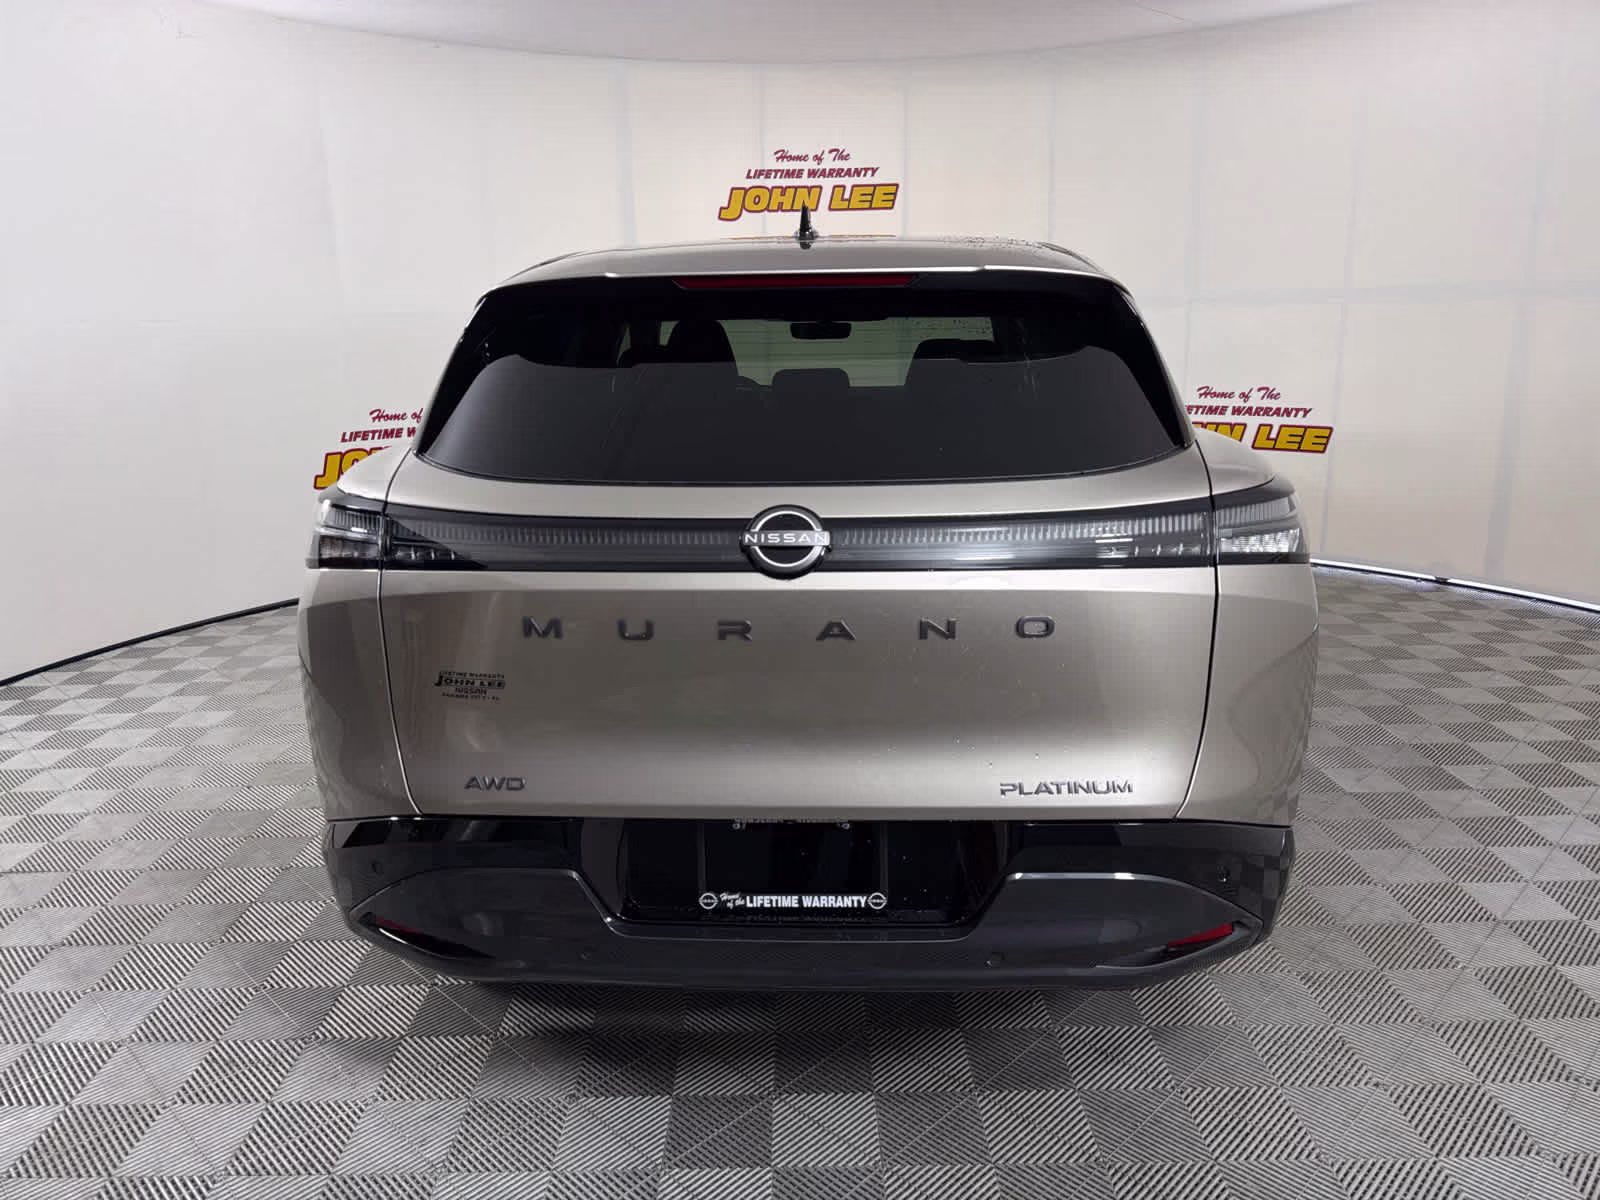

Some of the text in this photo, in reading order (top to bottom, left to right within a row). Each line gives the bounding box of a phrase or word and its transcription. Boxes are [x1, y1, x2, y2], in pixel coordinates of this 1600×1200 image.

[774, 148, 850, 165] Home of The
[745, 166, 880, 180] LIFETIME WARRANTY
[718, 183, 899, 221] JOHN LEE
[1197, 386, 1281, 402] Home of The
[369, 408, 423, 424] Home of
[1185, 405, 1313, 418] ETIME WARRANTY
[340, 427, 403, 443] LIFETIME
[1251, 423, 1333, 454] LEE
[744, 533, 827, 545] NISSAN
[522, 616, 1056, 641] MURANO
[434, 675, 475, 687] JOHN
[464, 776, 526, 791] AWD
[1000, 780, 1133, 795] PLATINUM
[746, 895, 868, 908] LIFETIME WARRANTY
